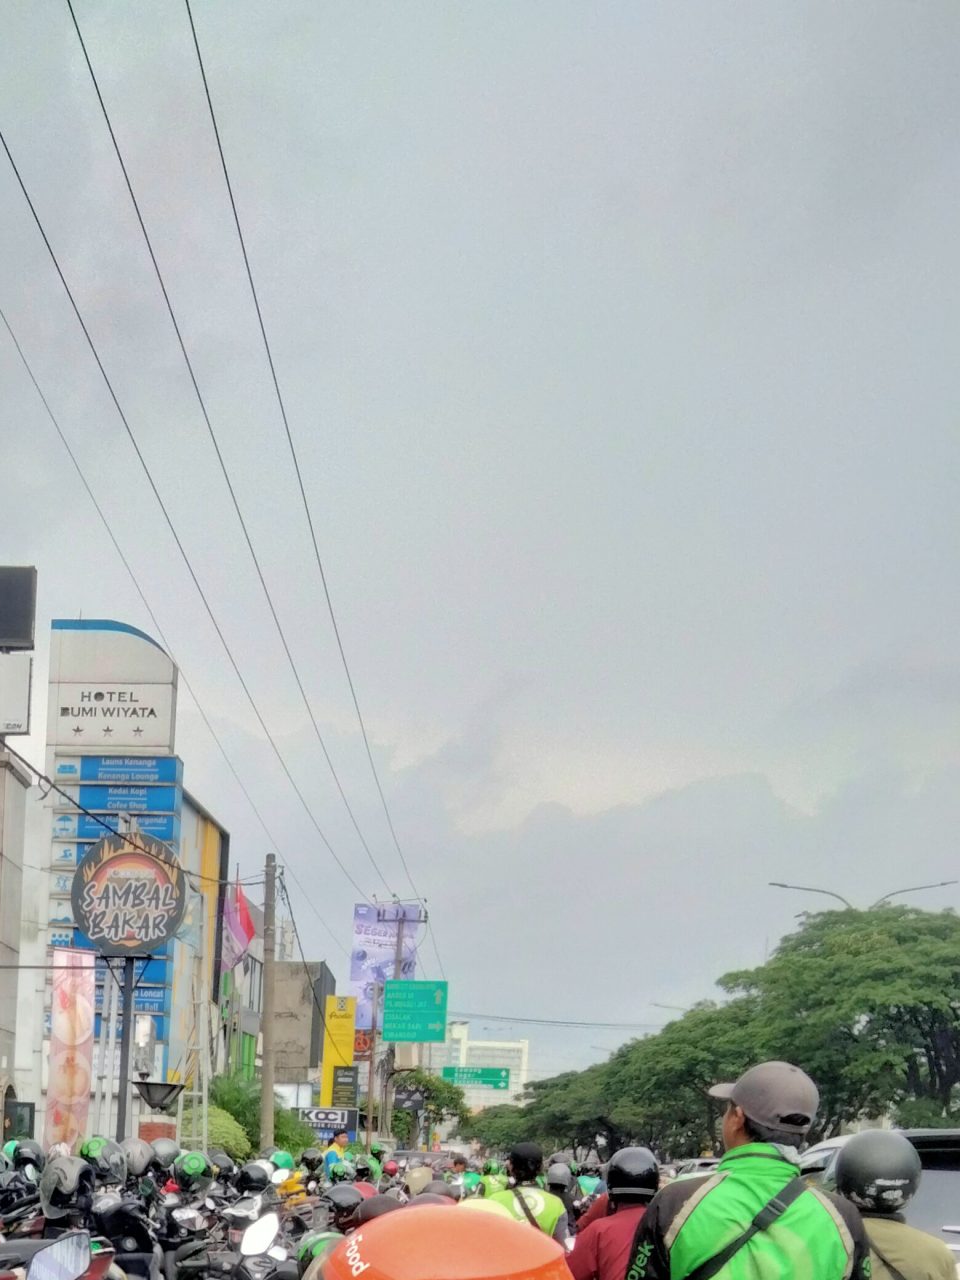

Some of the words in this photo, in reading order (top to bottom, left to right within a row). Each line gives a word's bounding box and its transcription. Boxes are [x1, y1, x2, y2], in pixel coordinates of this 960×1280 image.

[81, 692, 139, 702] HOTEL
[60, 706, 97, 717] BUMI
[101, 707, 157, 718] WIYATA
[82, 880, 176, 911] SAMBAL
[88, 910, 168, 941] BAKAR
[301, 1111, 346, 1123] KOCI
